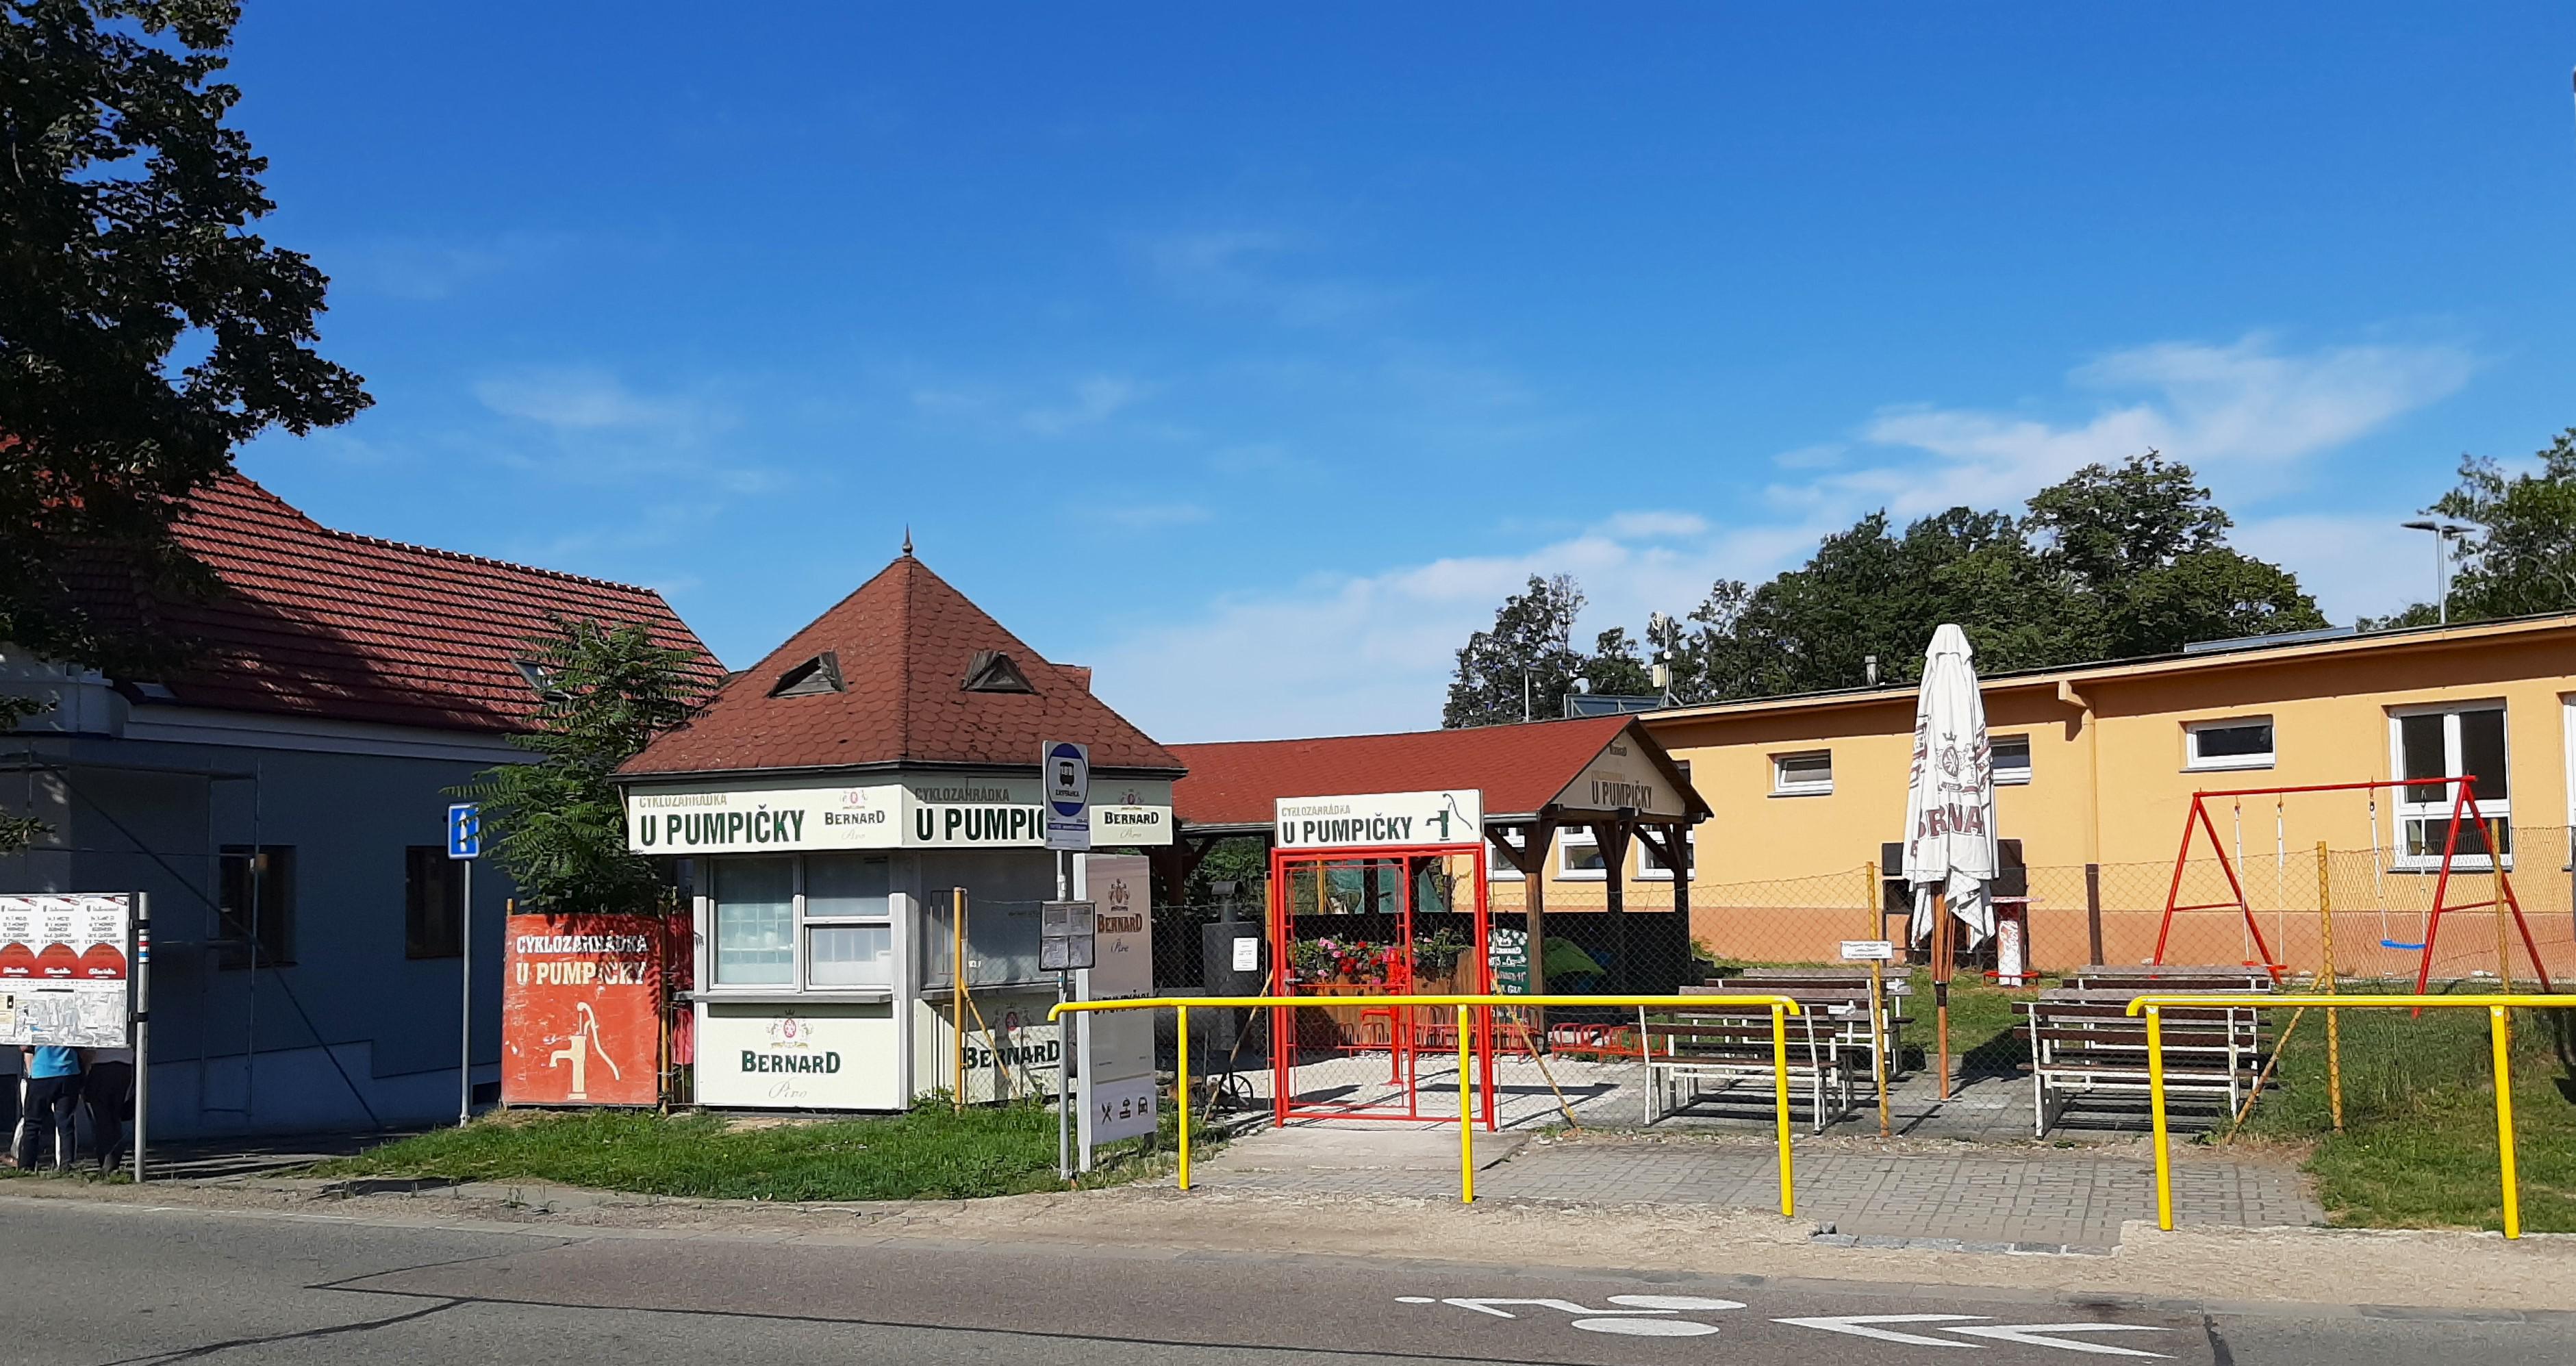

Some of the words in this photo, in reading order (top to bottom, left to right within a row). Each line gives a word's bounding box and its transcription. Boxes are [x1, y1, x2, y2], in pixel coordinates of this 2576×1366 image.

[915, 787, 1010, 802] CYKLOZAHRÁDKA
[1592, 781, 1599, 805] U
[1602, 781, 1652, 809] PUMPIČKY
[824, 810, 885, 825] BERNARD
[1104, 811, 1159, 825] BERNARD
[1281, 802, 1351, 817] CYKLOZAHRÁDKA
[641, 814, 656, 846] U
[667, 804, 805, 845] PUMPIČKY
[916, 808, 933, 841] U
[945, 808, 1044, 841] PUMPI
[1283, 821, 1295, 844] U
[1303, 812, 1413, 844] PUMPIČKY
[1096, 913, 1142, 933] BERNARD
[516, 962, 530, 985] U
[740, 1050, 842, 1074] BERNARD
